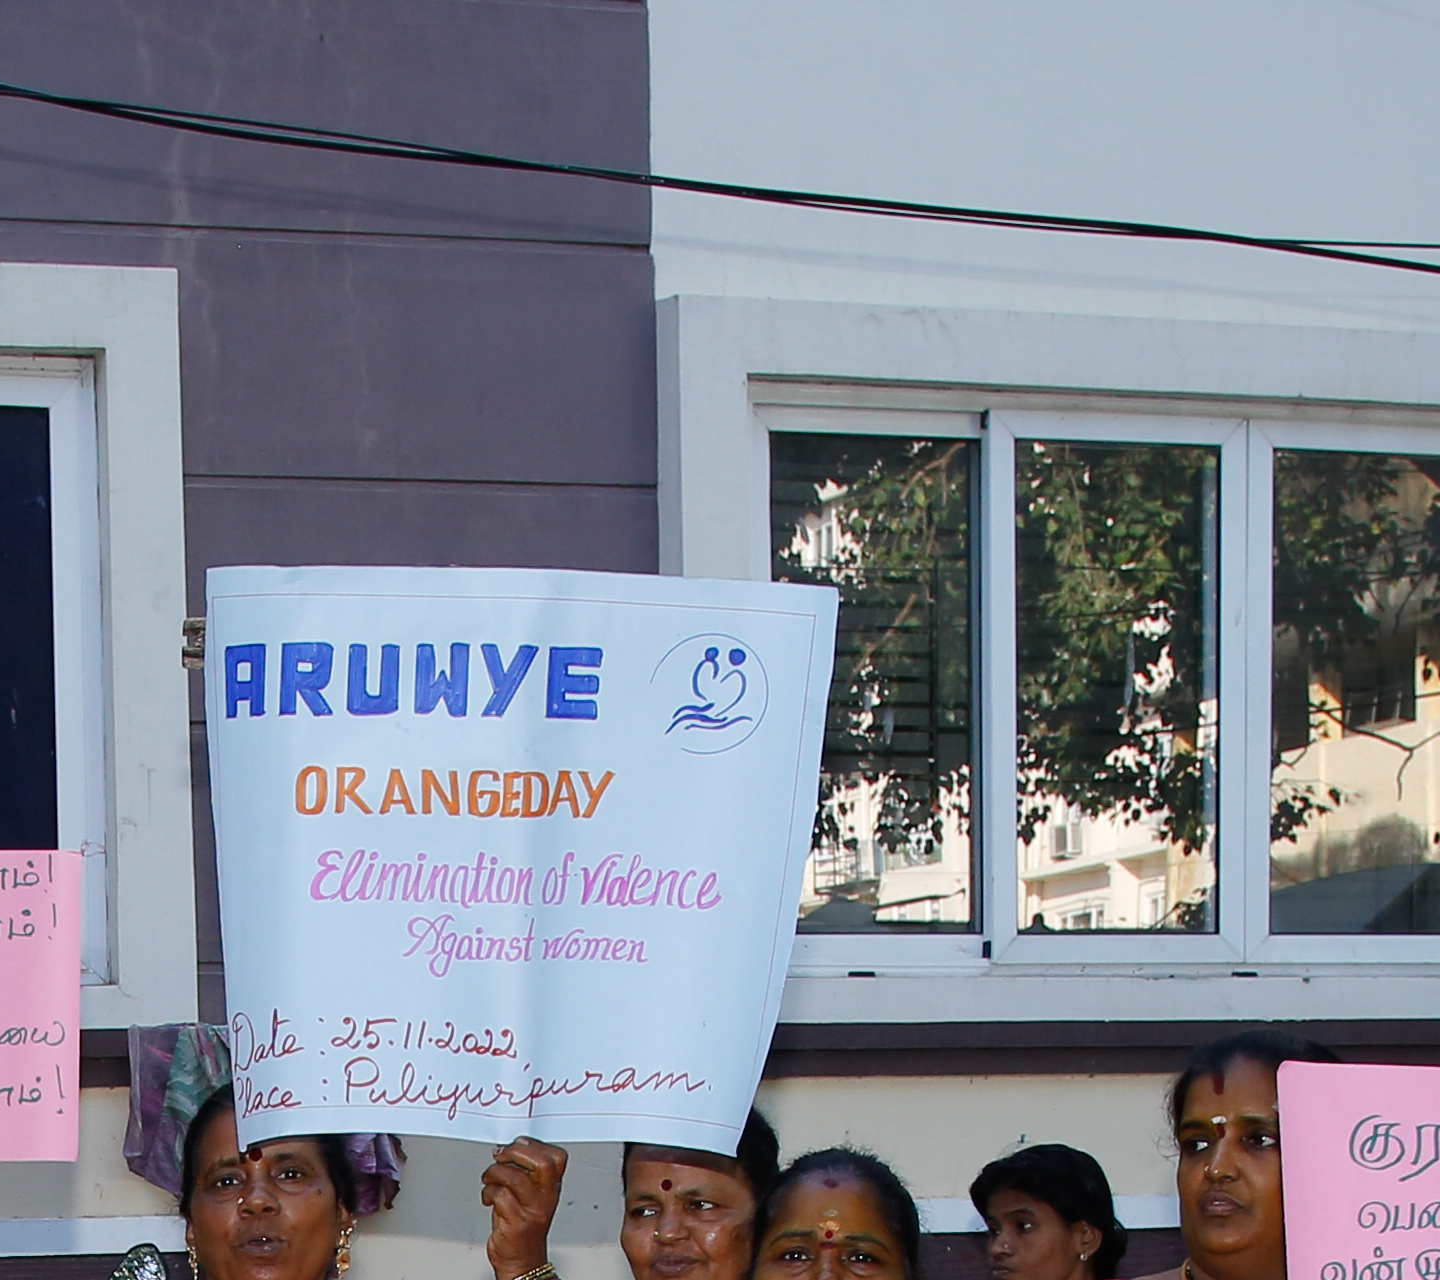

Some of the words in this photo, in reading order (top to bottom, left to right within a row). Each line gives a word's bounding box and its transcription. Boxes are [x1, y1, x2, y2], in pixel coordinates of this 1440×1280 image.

[224, 641, 604, 719] ARUWYE
[309, 848, 534, 908] Elimination
[540, 851, 576, 906] of
[402, 913, 536, 978] Against
[330, 1016, 518, 1059] 25.11.2022
